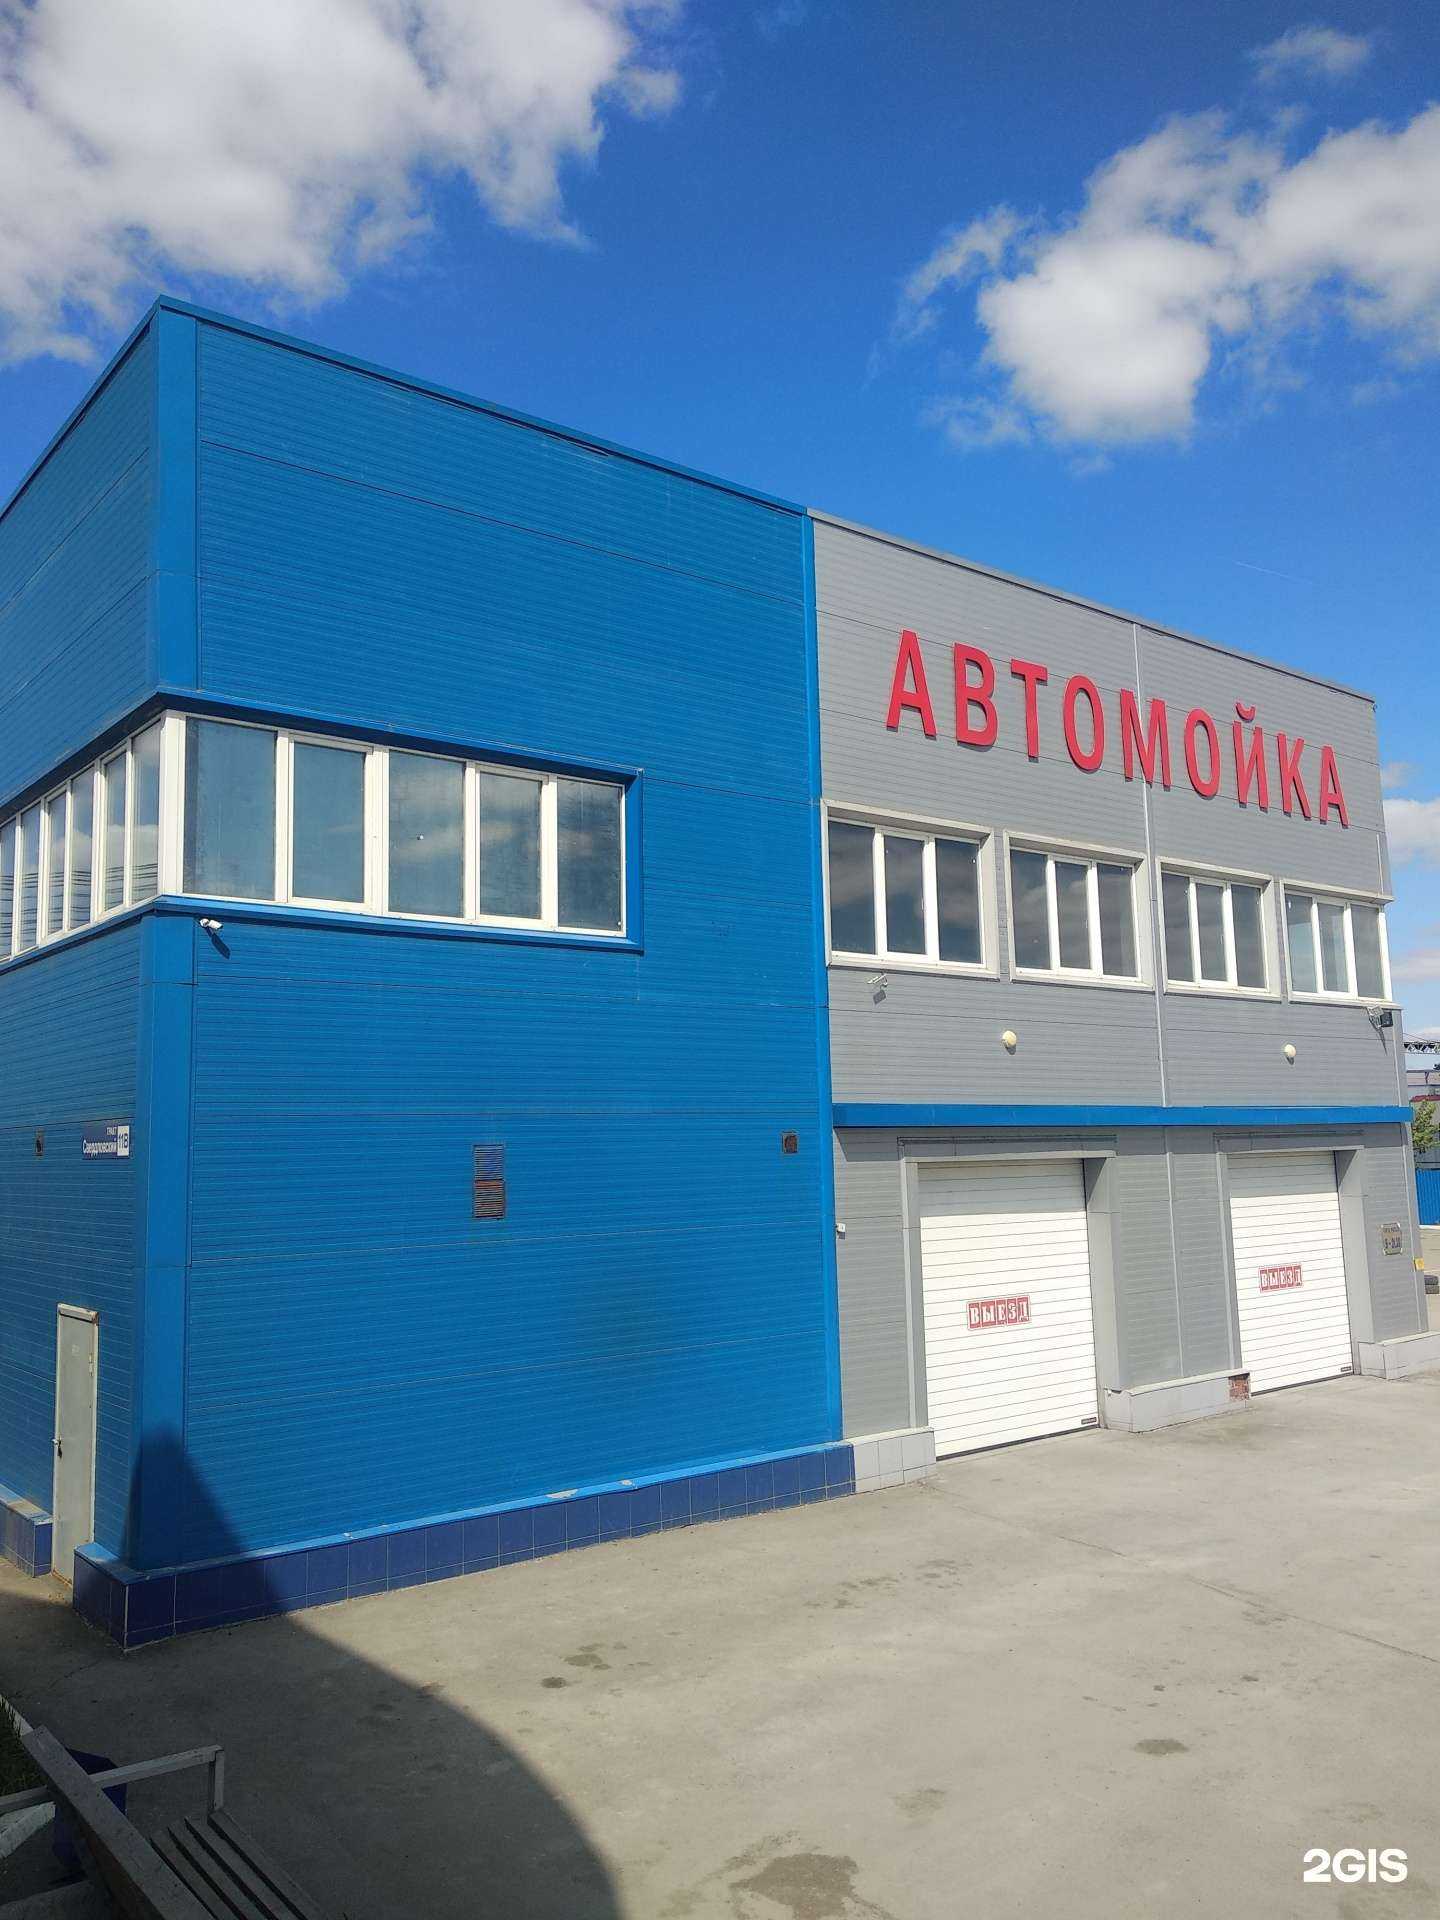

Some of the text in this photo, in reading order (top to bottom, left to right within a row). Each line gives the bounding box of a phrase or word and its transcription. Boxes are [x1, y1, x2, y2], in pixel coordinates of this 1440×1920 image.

[886, 629, 1349, 827] АВТОМОЙКА
[1260, 1268, 1302, 1288] ВЫЕЗД
[969, 1300, 1029, 1326] ВЫЕЗД
